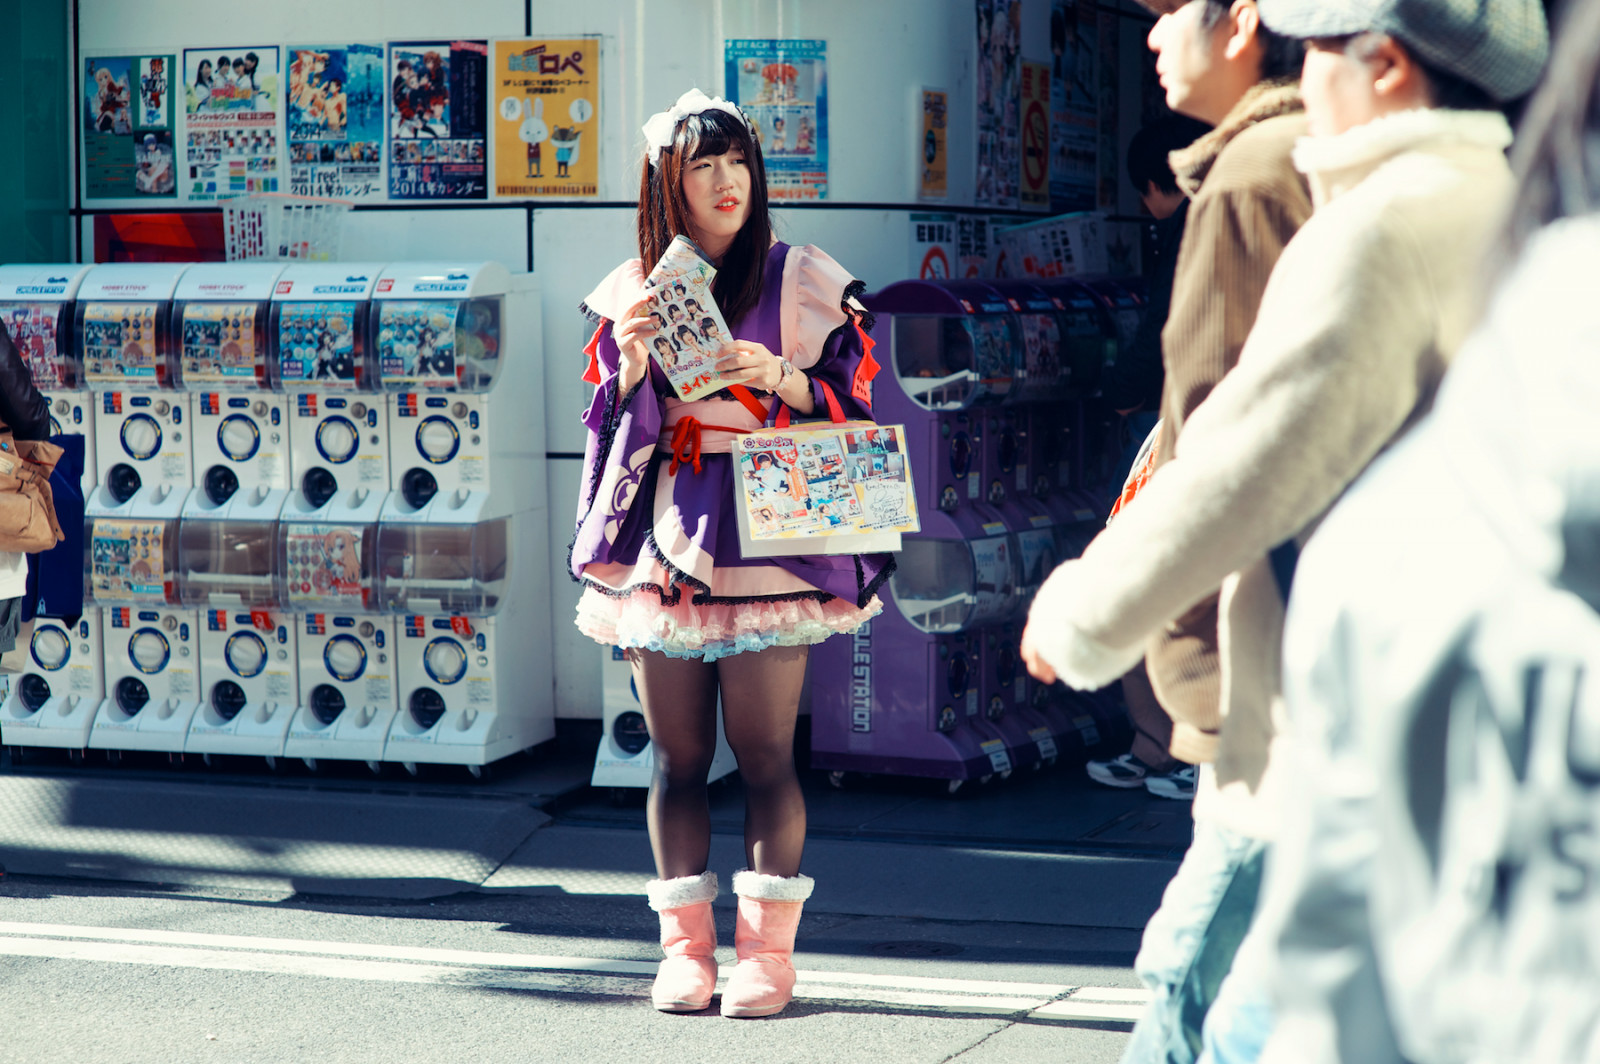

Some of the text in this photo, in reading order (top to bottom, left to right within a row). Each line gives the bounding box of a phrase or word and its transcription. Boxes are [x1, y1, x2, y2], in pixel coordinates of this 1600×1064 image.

[291, 184, 380, 198] 2014年カレンダー
[391, 182, 484, 196] 2014年カレンダー
[853, 666, 871, 733] STATION
